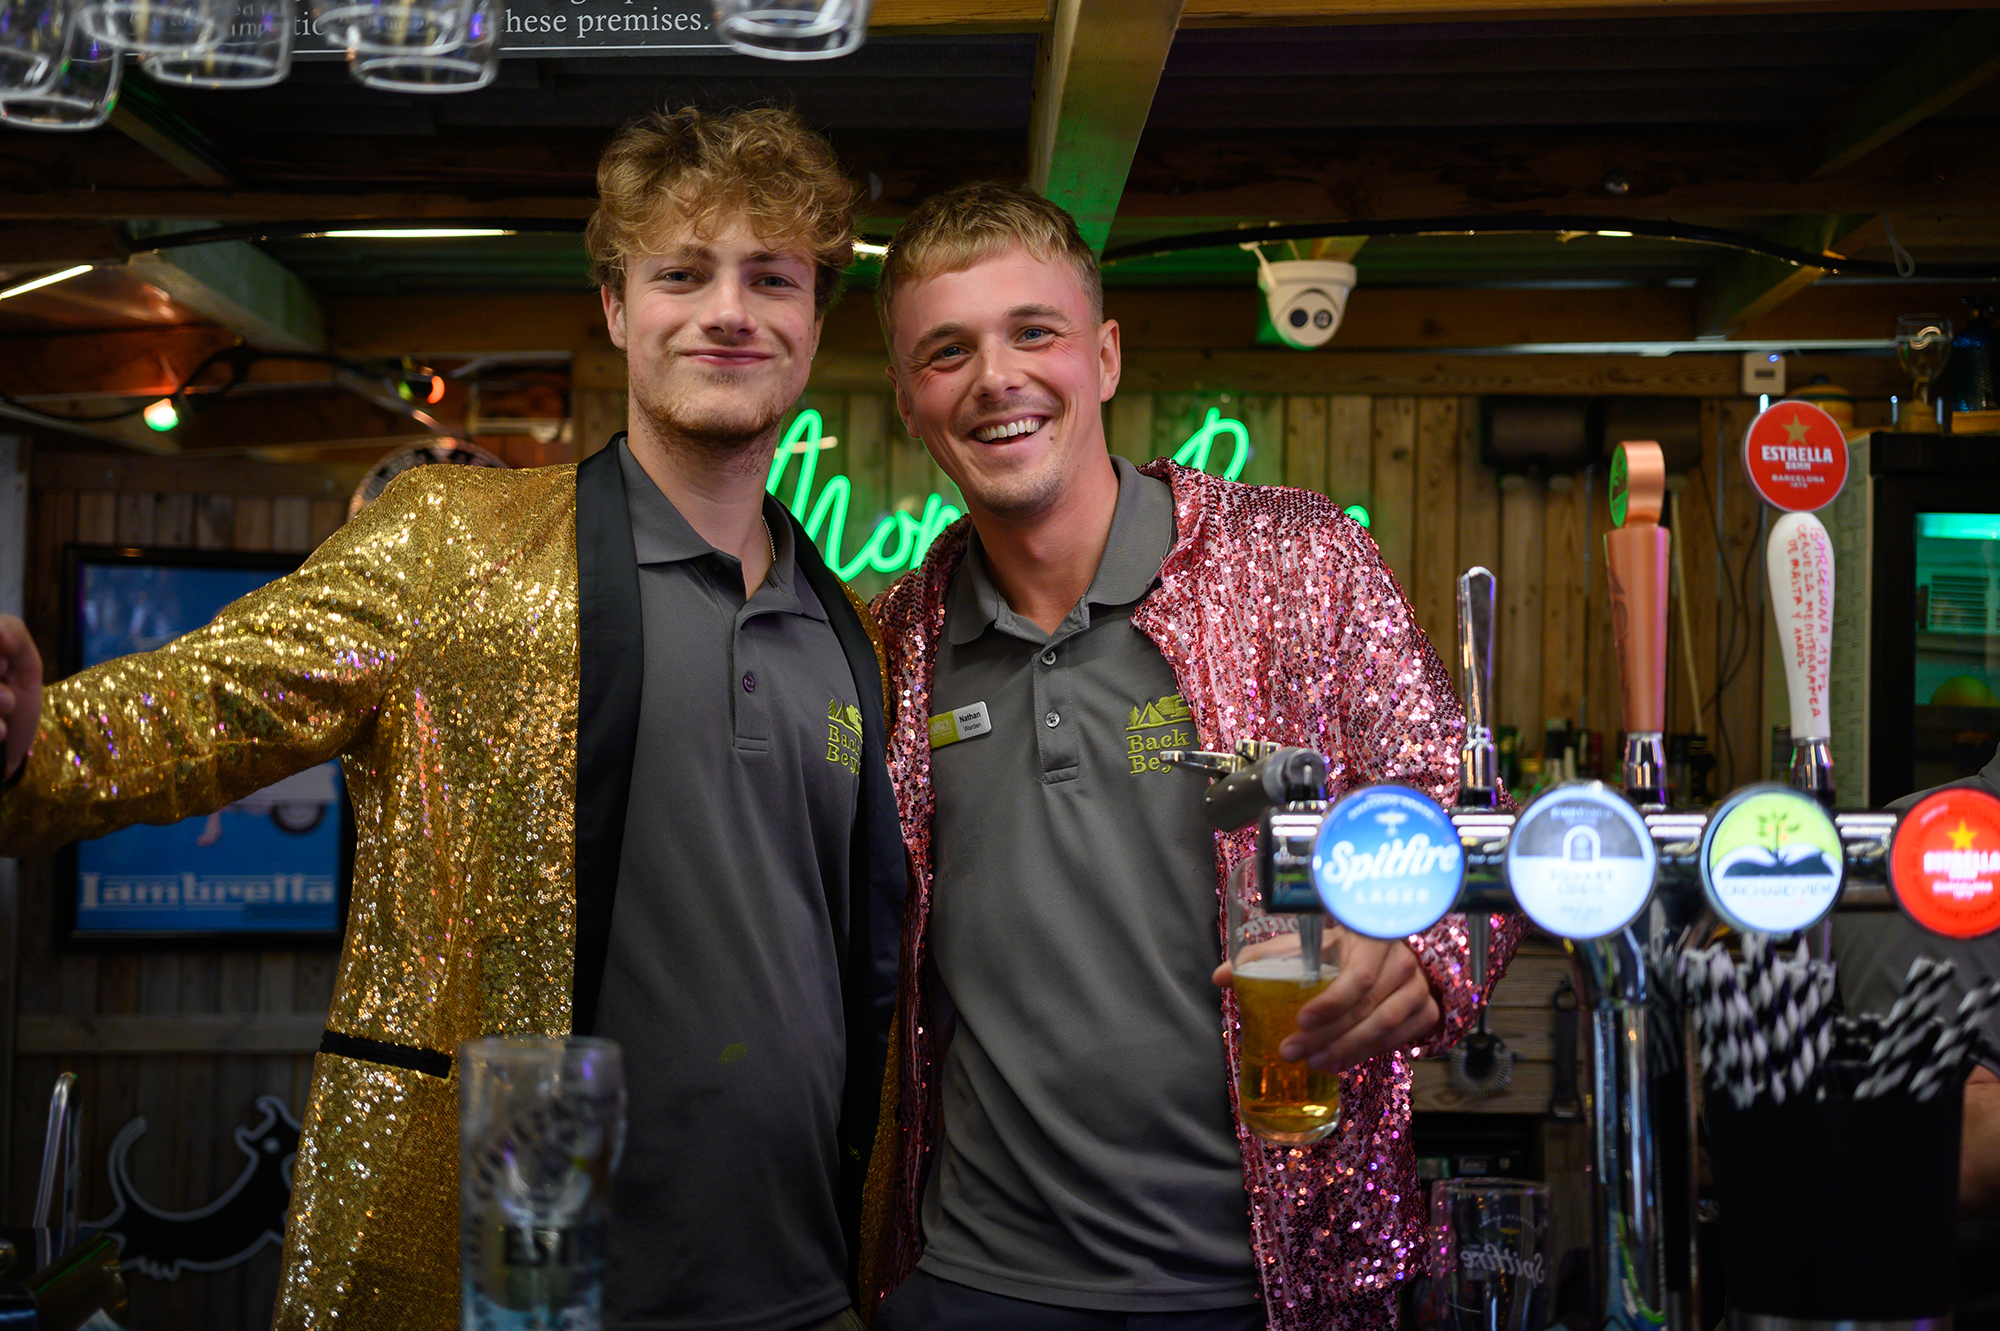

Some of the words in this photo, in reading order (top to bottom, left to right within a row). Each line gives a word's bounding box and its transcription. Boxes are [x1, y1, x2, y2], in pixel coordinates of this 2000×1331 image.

[500, 9, 567, 34] hese
[576, 6, 711, 39] premises.
[1761, 445, 1834, 463] ESTRELLA
[1771, 474, 1826, 484] BARCELONA
[1787, 539, 1799, 555] DE
[1797, 523, 1815, 594] CERVEZA
[1790, 558, 1804, 606] MALTA
[1791, 611, 1803, 620] Y
[958, 711, 982, 724] Nathan
[962, 722, 983, 732] Warden
[1126, 729, 1191, 755] Back
[826, 742, 861, 775] Bey
[1322, 833, 1461, 893] Spitfire
[1354, 887, 1431, 906] LAGER
